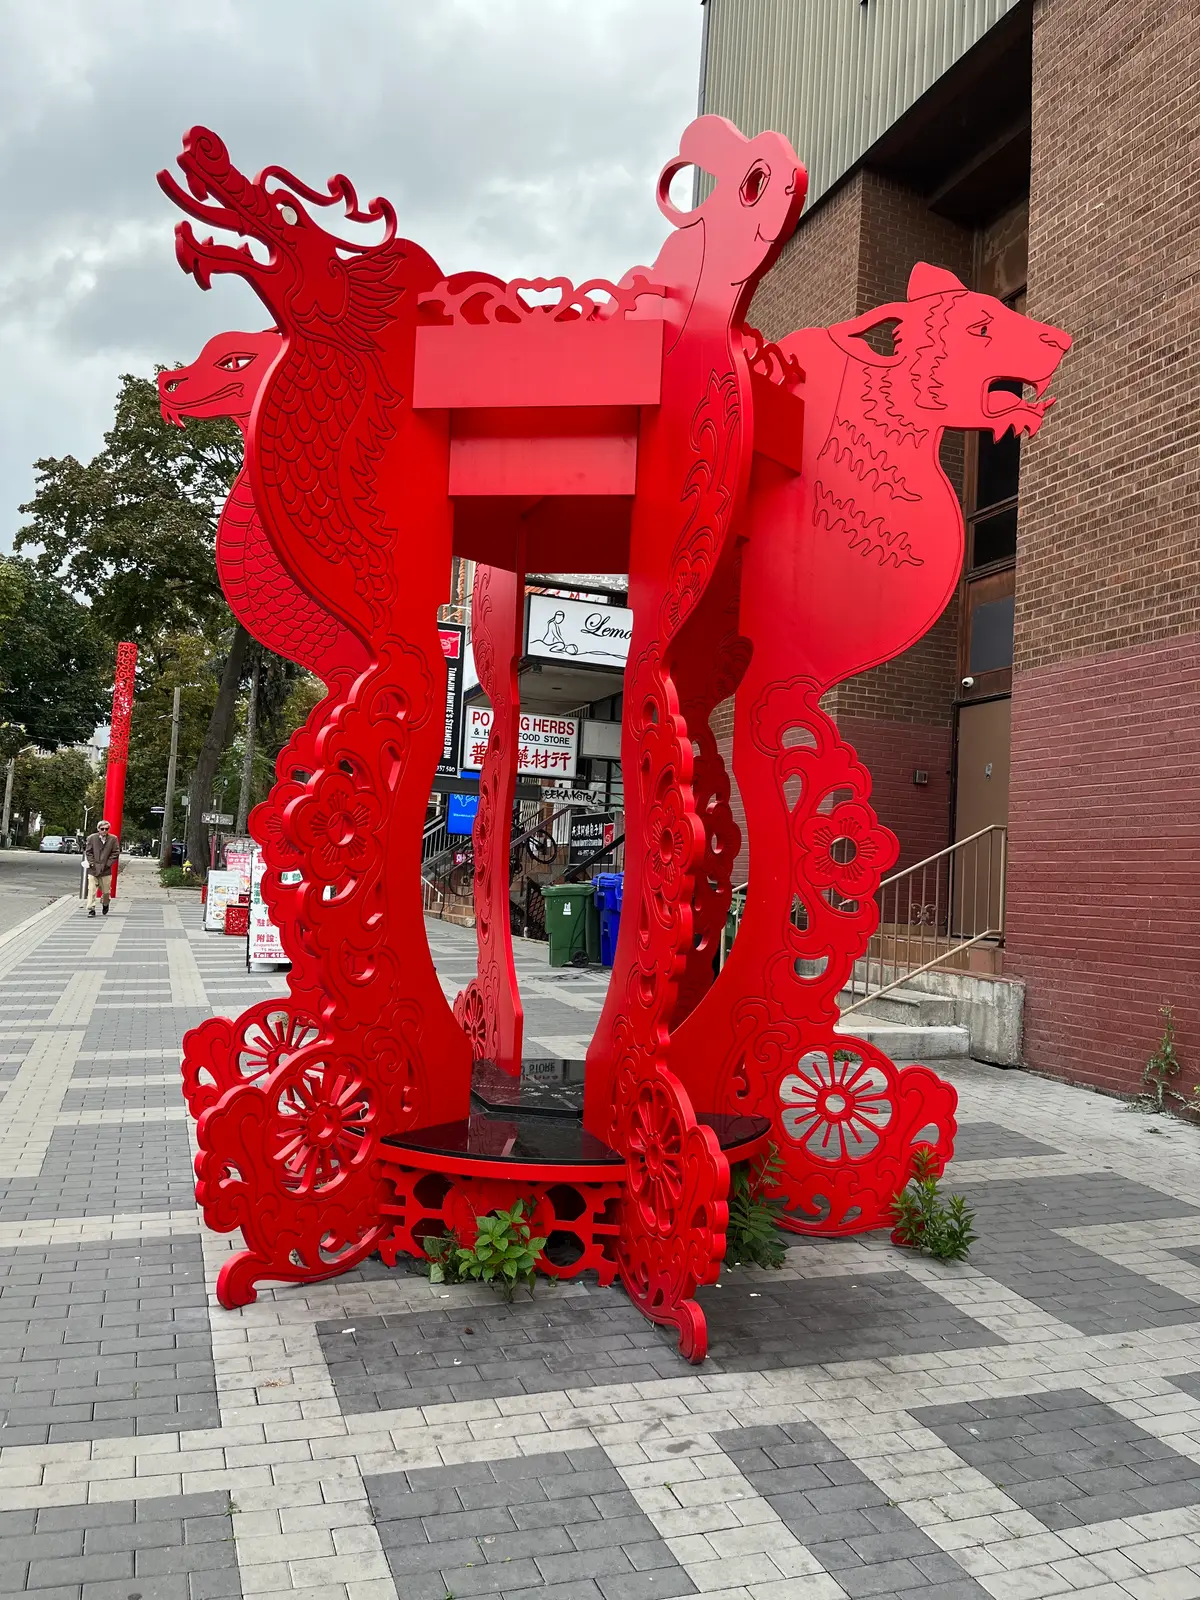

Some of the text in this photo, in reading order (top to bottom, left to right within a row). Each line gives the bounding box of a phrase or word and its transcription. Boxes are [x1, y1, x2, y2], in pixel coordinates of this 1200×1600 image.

[442, 667, 457, 759] TIANJIN AUNTIE'S STEAMED BUN
[533, 717, 575, 736] HERBS
[473, 728, 480, 736] &
[543, 735, 570, 745] STORE
